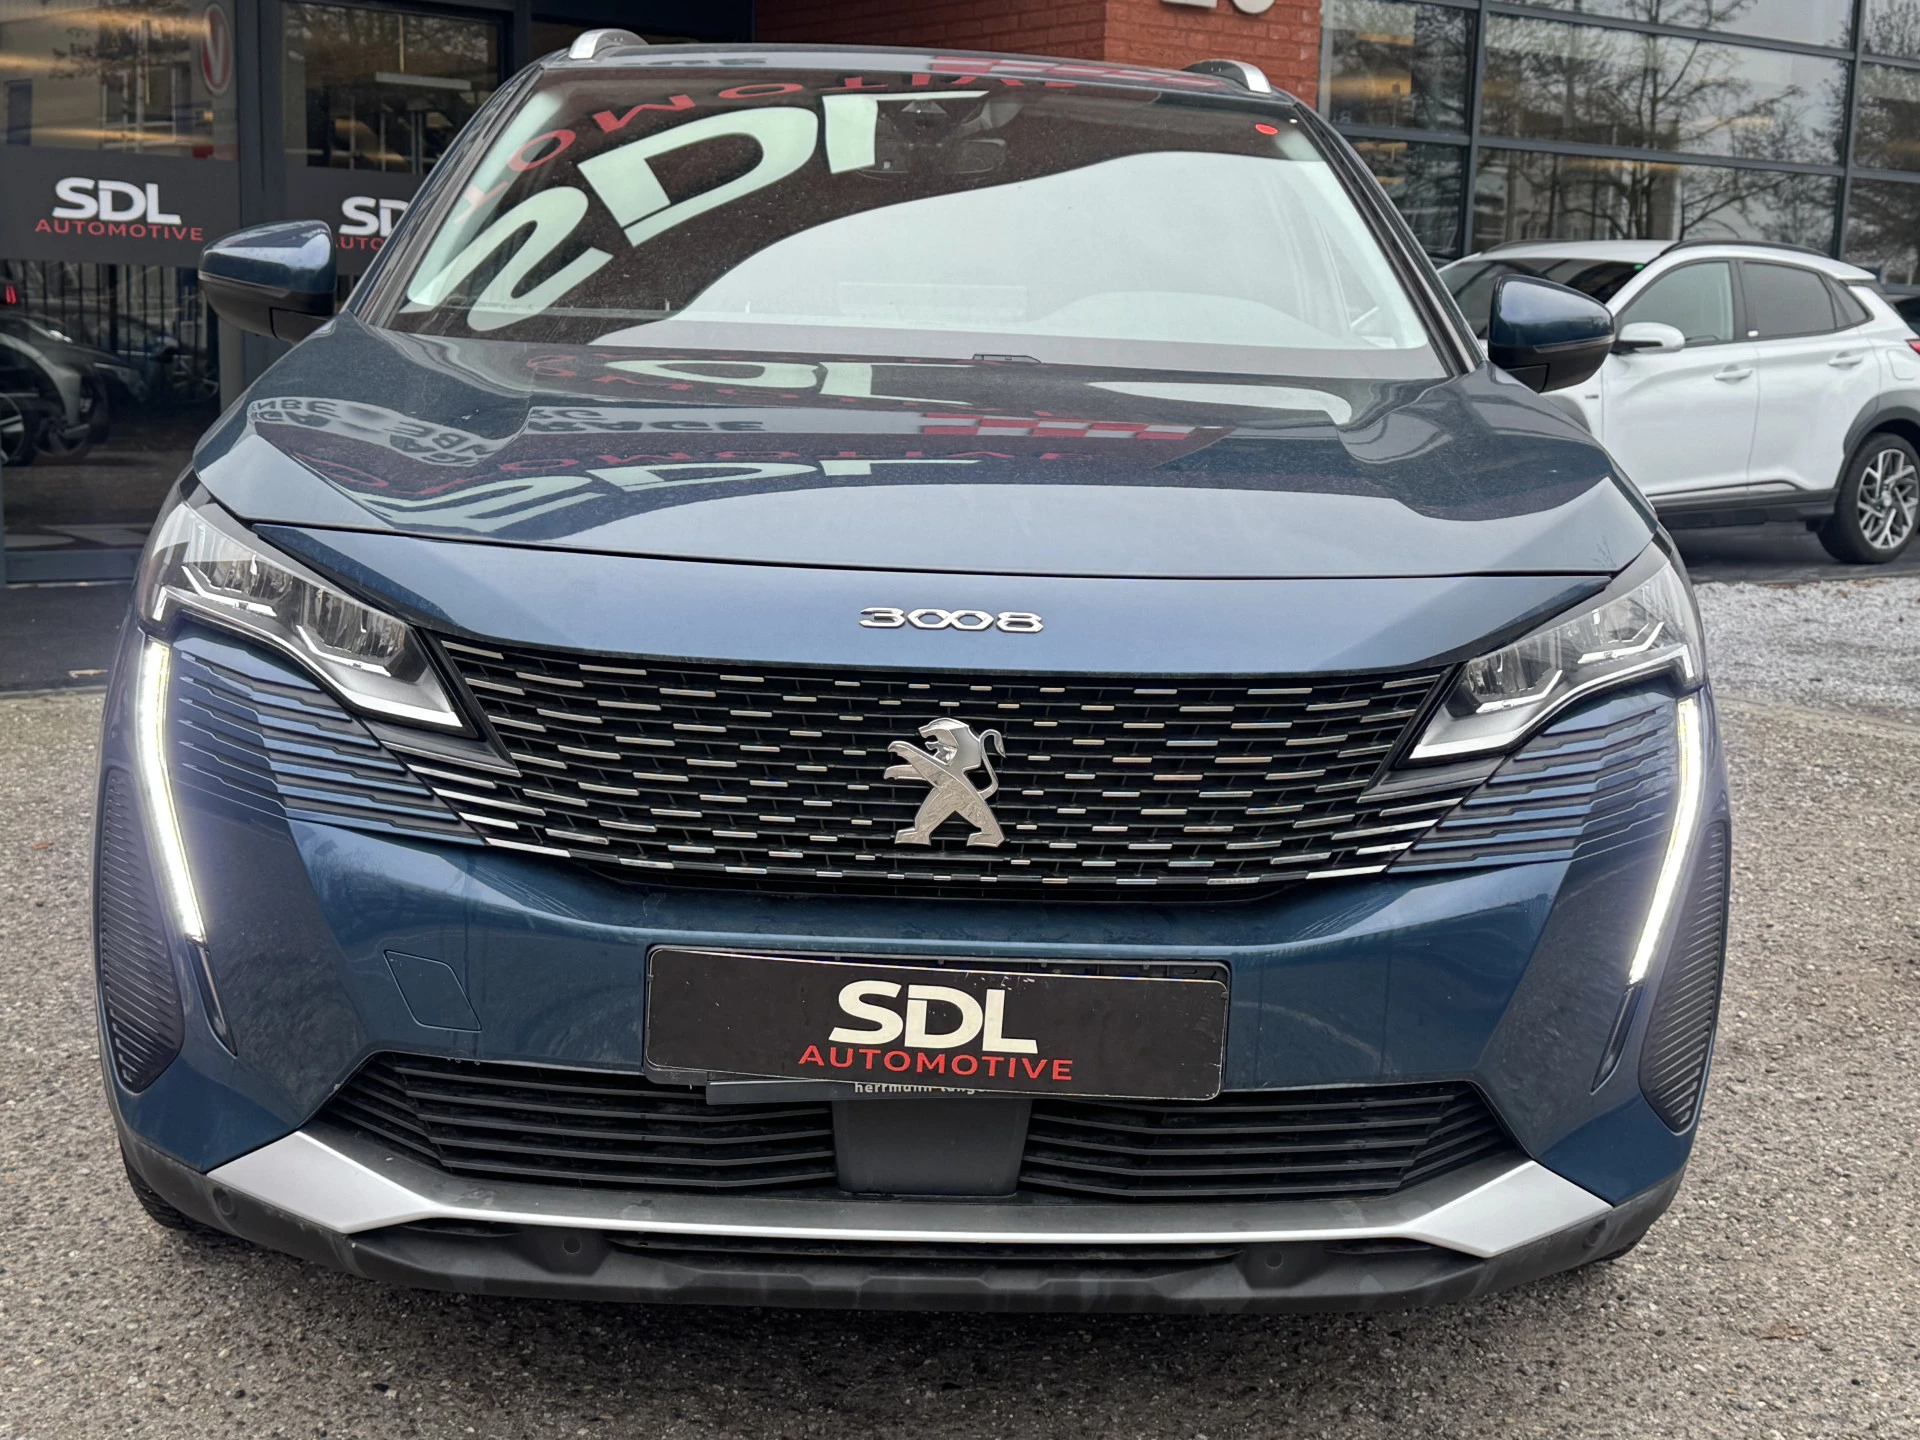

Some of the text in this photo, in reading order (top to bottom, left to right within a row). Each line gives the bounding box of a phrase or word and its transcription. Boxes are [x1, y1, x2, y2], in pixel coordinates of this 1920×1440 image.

[52, 176, 182, 225] SDL
[34, 218, 204, 241] AUTOMOTIVE
[859, 607, 1044, 633] 3008
[828, 979, 1039, 1054] SDL
[798, 1045, 1074, 1081] AUTOMOTIVE
